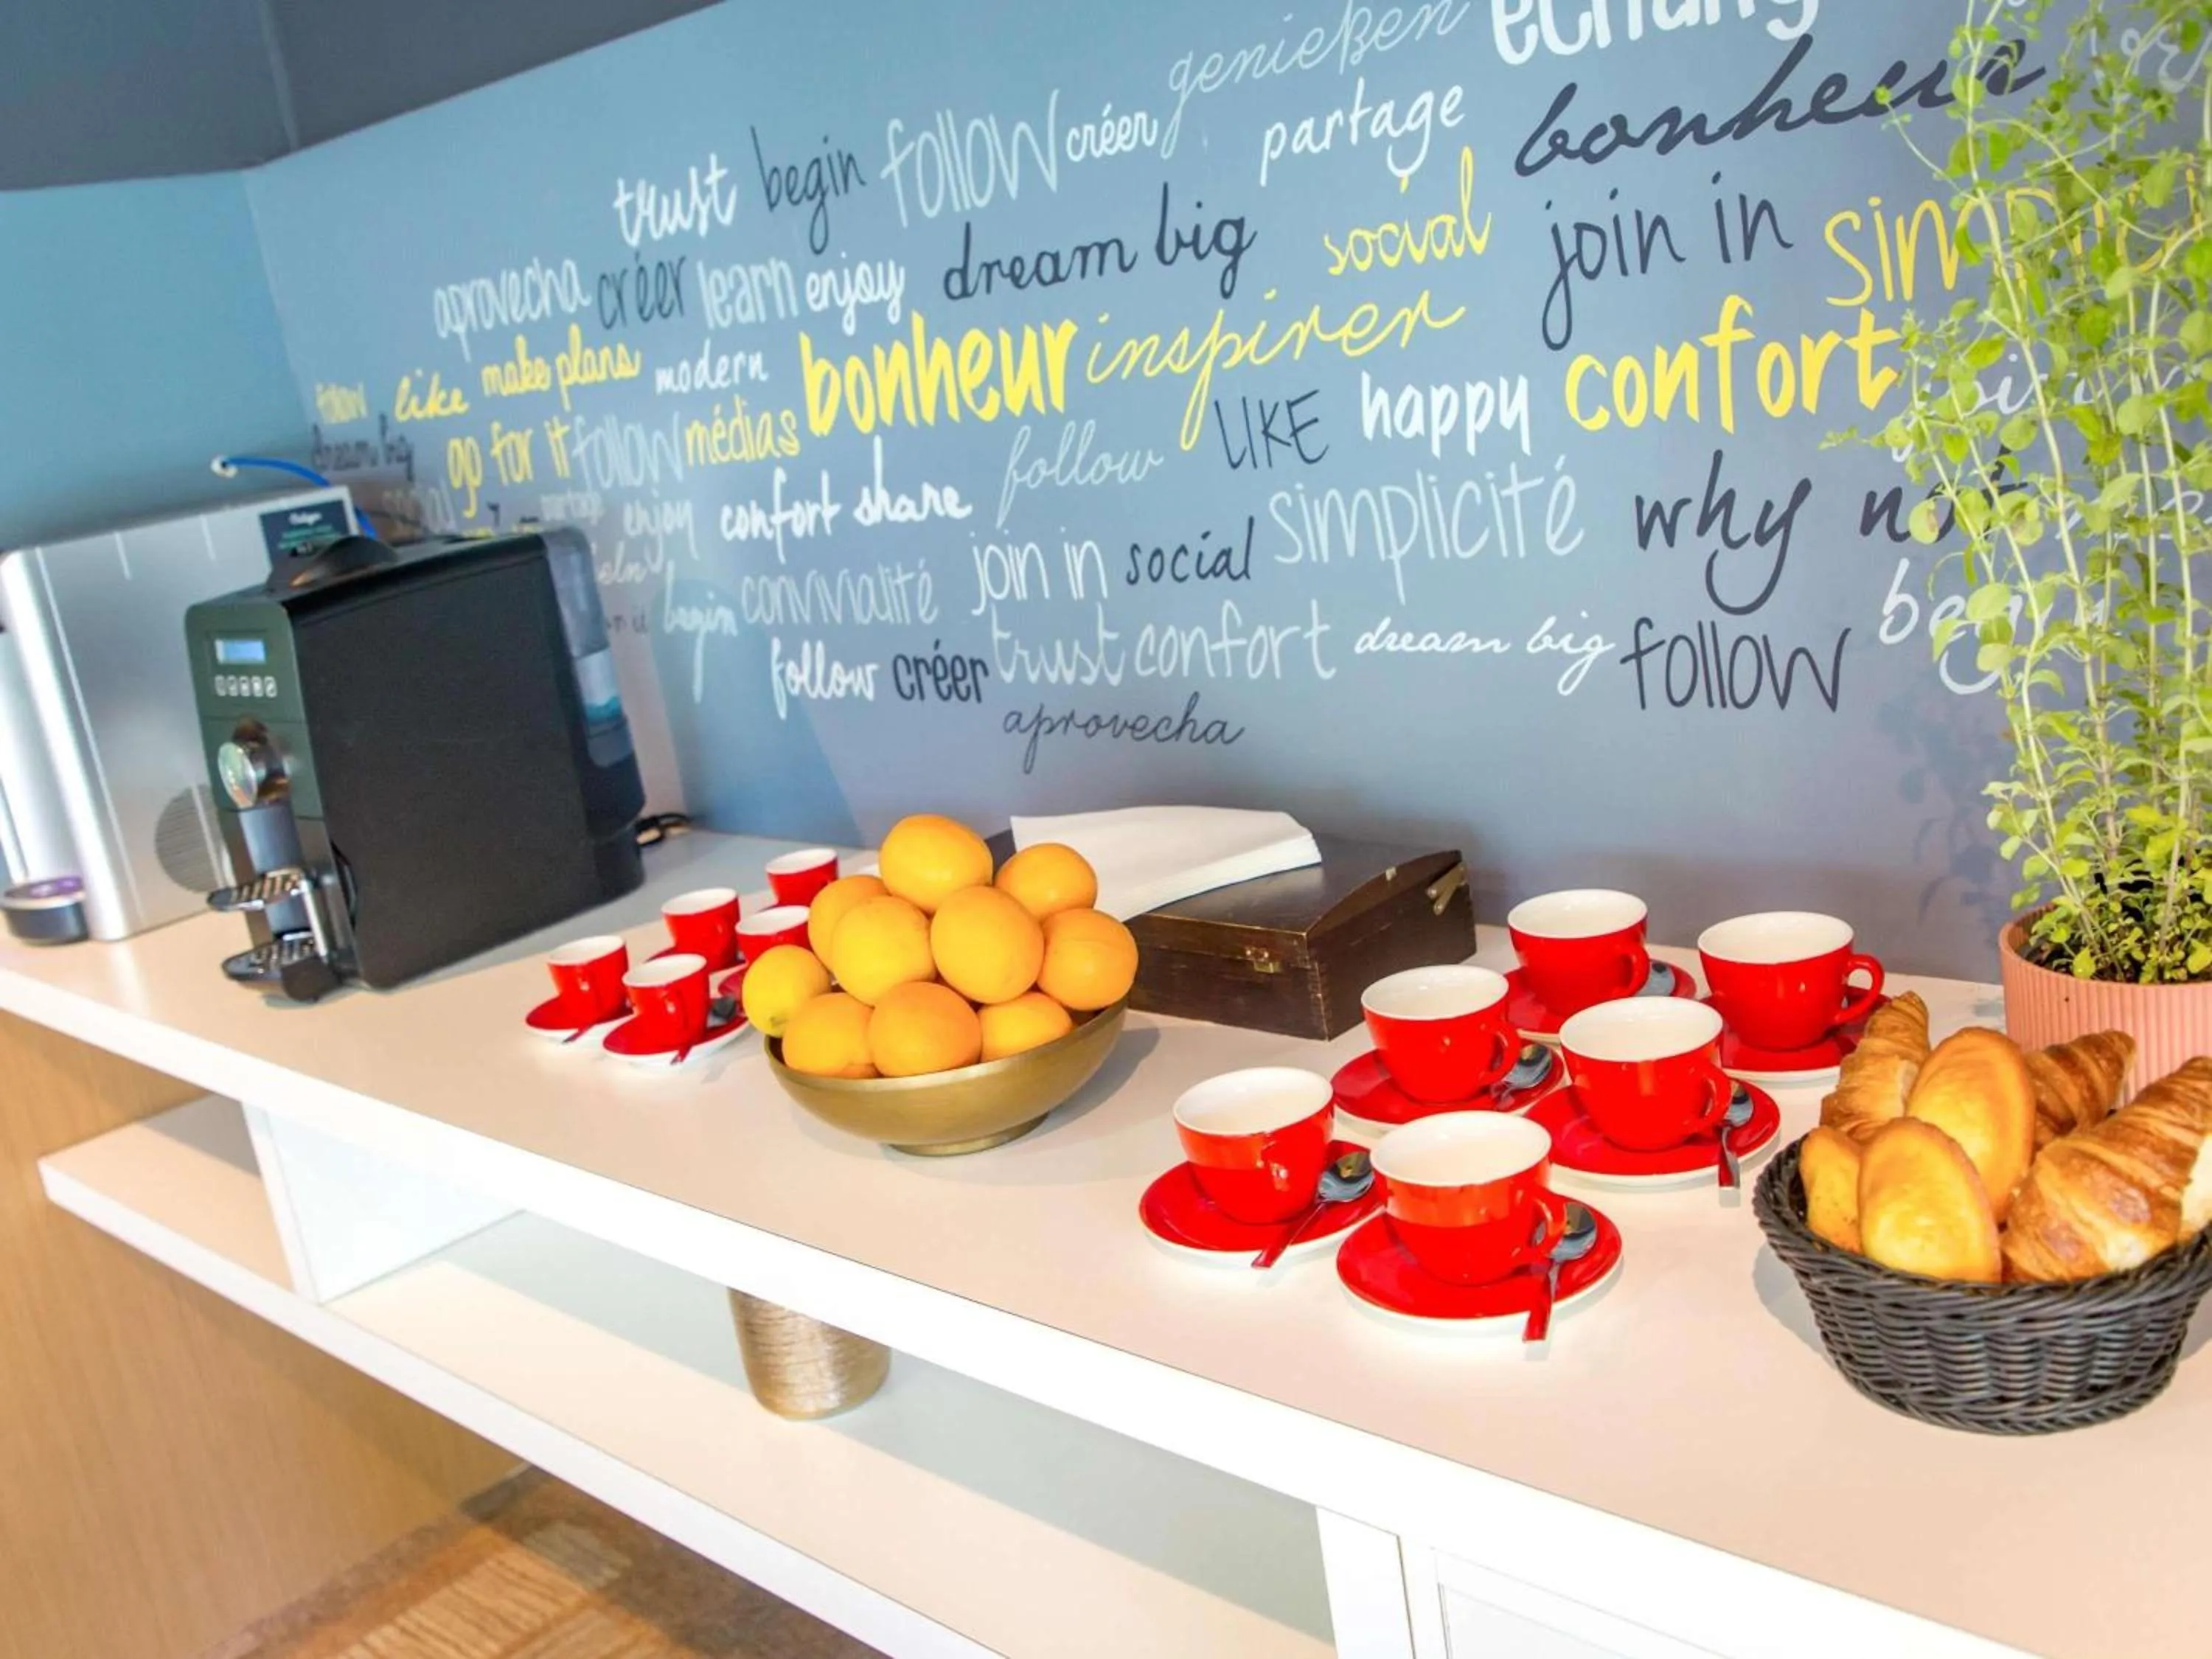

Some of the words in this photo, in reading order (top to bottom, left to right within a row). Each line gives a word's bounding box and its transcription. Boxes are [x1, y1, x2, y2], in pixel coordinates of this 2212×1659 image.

[1162, 0, 1470, 159] genießen
[880, 88, 1059, 228] follow
[1066, 102, 1158, 161] créer
[1261, 77, 1465, 187] partage
[613, 153, 737, 247] trust
[750, 125, 866, 255] begin
[1324, 147, 1492, 276] social
[944, 221, 1138, 301] dream
[1155, 181, 1257, 299] big
[1543, 187, 1686, 351] join
[1712, 170, 1794, 264] in
[434, 256, 591, 362] aprovecha
[597, 251, 687, 330] créer
[697, 256, 799, 329] learn
[806, 252, 905, 336] enjoy
[394, 369, 470, 422] like
[481, 333, 552, 397] make
[555, 323, 641, 411] plans
[655, 338, 768, 394] modern
[799, 310, 1077, 437] bonheur
[1087, 289, 1466, 451] inspirer
[1565, 294, 1901, 435] confort
[684, 394, 800, 467] médias
[1215, 390, 1329, 470] LIKE
[1361, 371, 1531, 459] happy
[448, 437, 483, 518] go
[491, 421, 534, 485] for
[544, 415, 571, 479] it
[852, 435, 973, 525] share
[996, 419, 1164, 528] follow
[720, 466, 841, 565] confort
[1126, 516, 1253, 585] social
[1268, 453, 1584, 605] simplicité
[1635, 449, 1812, 616] why
[970, 528, 1049, 616] join
[1060, 526, 1108, 600] in
[770, 636, 880, 720] follow
[892, 639, 990, 703] créer
[990, 600, 1125, 686] trust
[1134, 598, 1337, 680] confort
[1354, 616, 1509, 655] dream
[1526, 611, 1616, 696] big
[1619, 616, 1851, 713] follow
[1003, 691, 1245, 774] aprovecha
